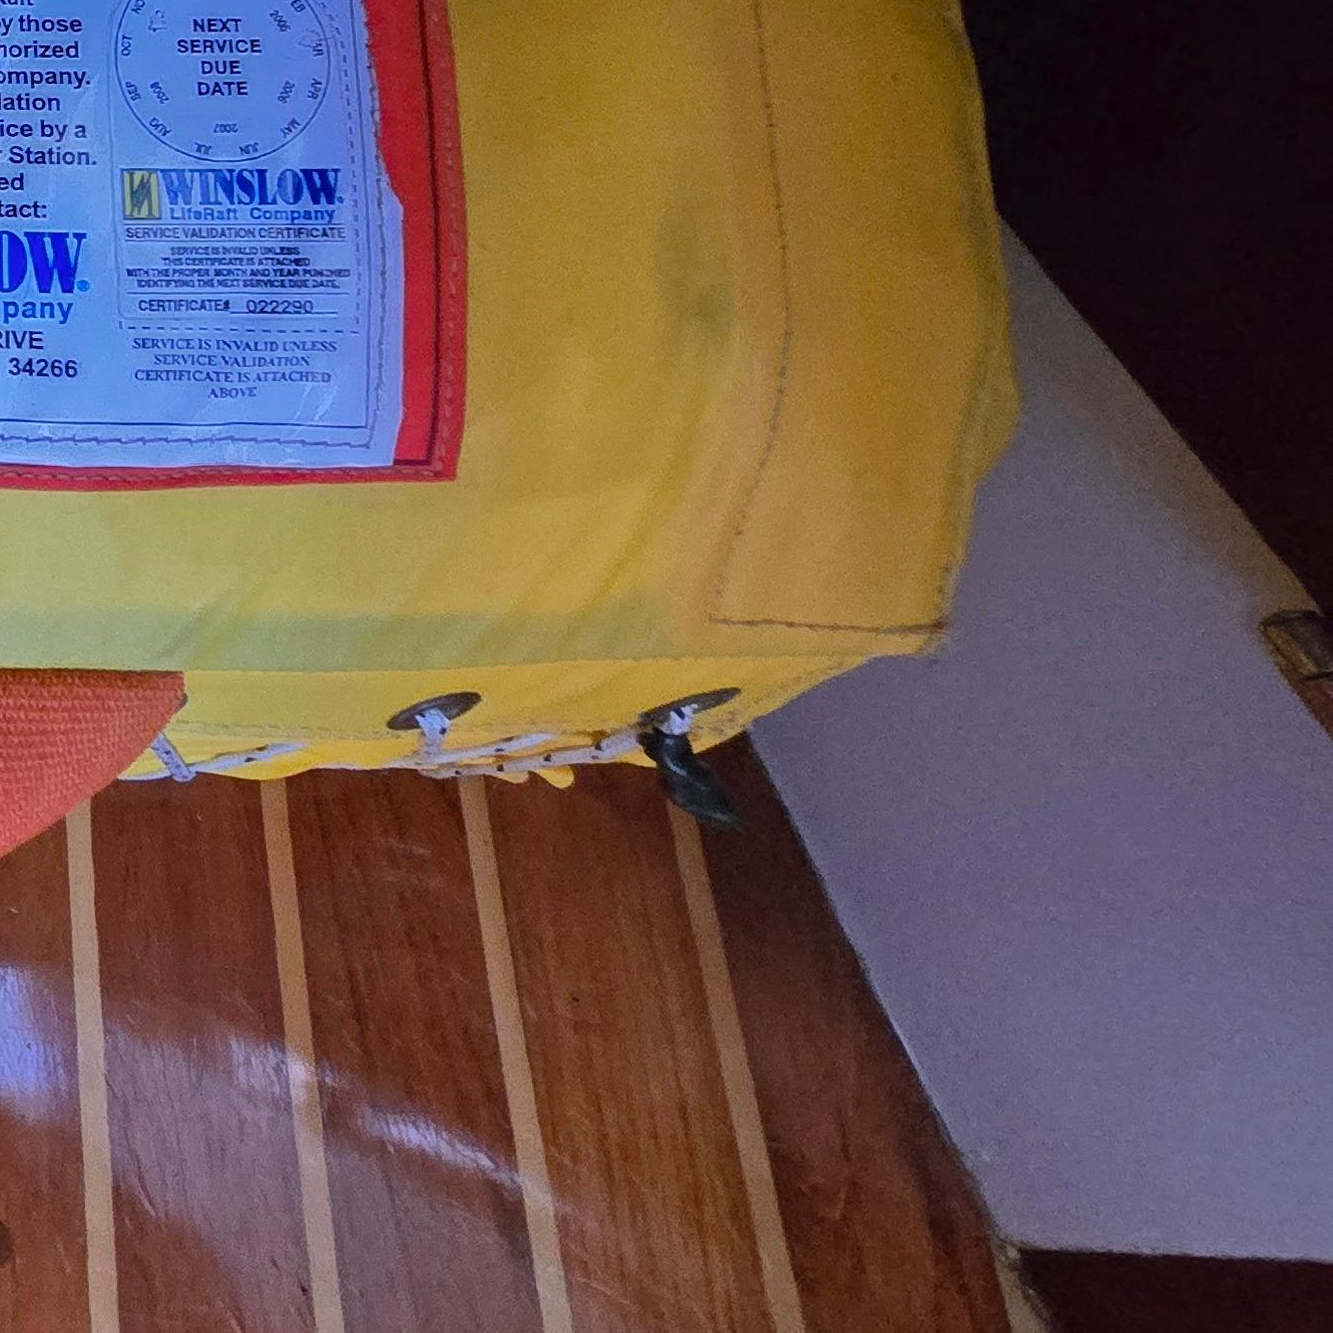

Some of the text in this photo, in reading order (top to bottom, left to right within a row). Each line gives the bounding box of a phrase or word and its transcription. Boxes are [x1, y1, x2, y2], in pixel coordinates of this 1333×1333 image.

[19, 15, 82, 33] those
[193, 19, 242, 32] NEXT
[121, 36, 132, 56] OCT
[177, 40, 262, 54] SERVICE
[201, 60, 241, 74] DUE
[197, 82, 249, 96] DATE
[41, 119, 66, 142] by
[74, 124, 87, 139] a
[9, 146, 97, 166] Station.
[170, 207, 336, 223] LifeRaft Company
[125, 227, 346, 239] SERVICE VALIDATION CERTIFICATE
[246, 300, 314, 314] 022290
[133, 338, 337, 352] SERVICE IS INVALID UNLESS
[8, 359, 78, 377] 34266
[154, 355, 310, 367] SERVICE VALIDATION
[135, 370, 331, 383] CERTIFICATE IS ATTACHED
[208, 387, 257, 398] ABOVE
